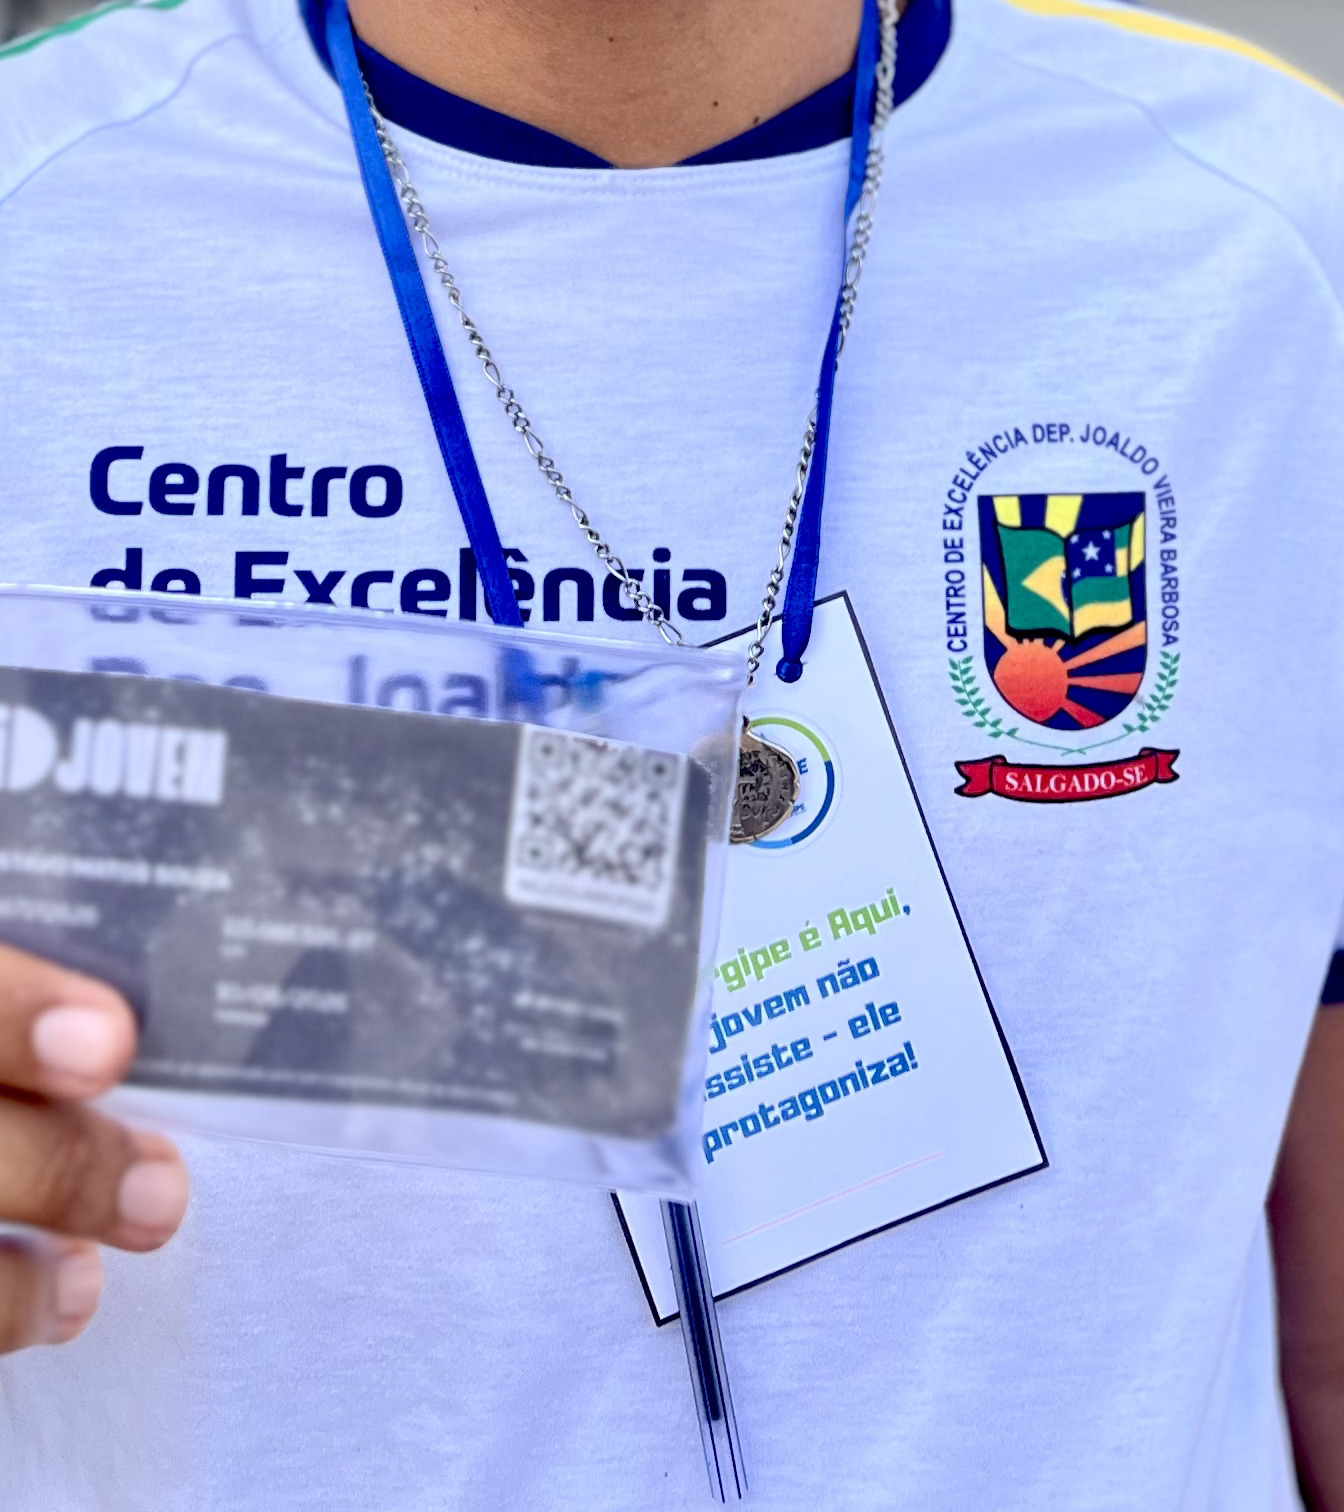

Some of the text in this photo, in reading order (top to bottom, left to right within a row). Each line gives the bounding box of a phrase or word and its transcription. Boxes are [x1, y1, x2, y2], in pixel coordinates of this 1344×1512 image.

[89, 446, 404, 519] Centro
[90, 547, 728, 626] de Excelência
[942, 423, 1179, 652] CENTRO DE EXCELÊNCIA DEP. JOALDO VIEIRA BARBOSA
[1005, 764, 1148, 794] SALGADO-SE
[712, 887, 911, 993] gipe é Aqui,
[704, 1036, 813, 1101] ssiste
[848, 1001, 902, 1040] ele
[709, 958, 880, 1054] jovem não
[703, 1040, 918, 1164] protagoniza!
